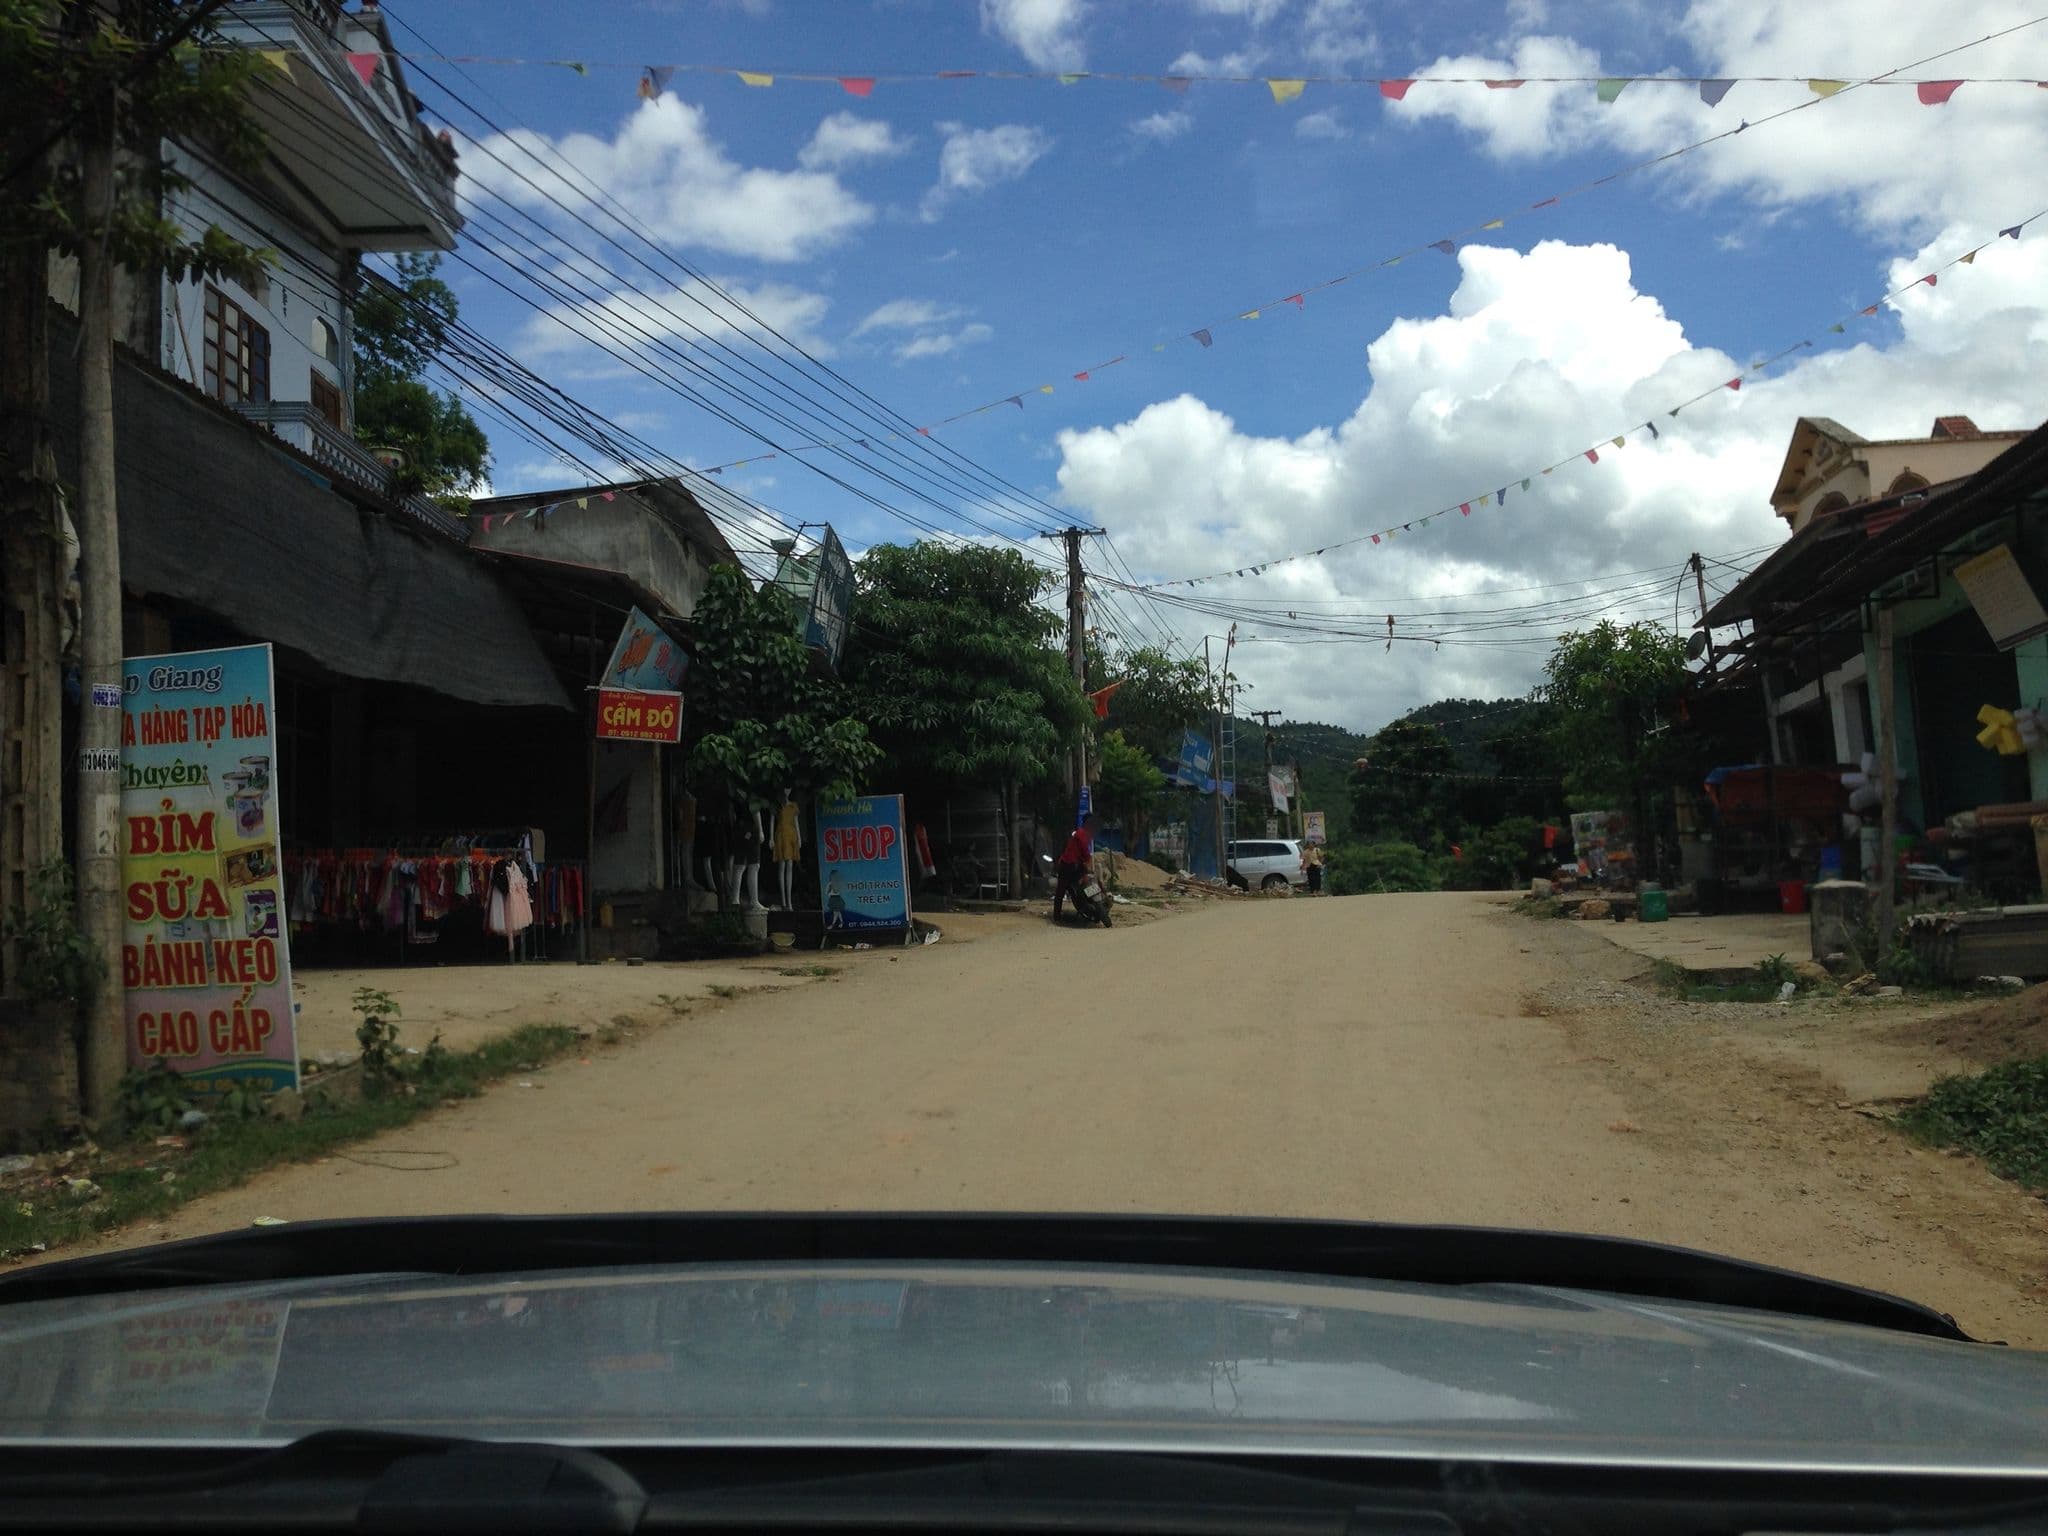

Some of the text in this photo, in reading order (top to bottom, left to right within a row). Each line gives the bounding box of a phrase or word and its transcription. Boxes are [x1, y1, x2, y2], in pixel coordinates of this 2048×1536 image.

[148, 664, 223, 693] Giang
[122, 696, 268, 749] A HÀNG TẠP HÓA
[602, 701, 674, 728] CẦM ĐỒ
[128, 798, 216, 855] BỈM
[823, 825, 896, 862] SHOP
[127, 868, 231, 921] SỮA
[867, 880, 900, 890] TRANG
[877, 894, 891, 904] EM
[123, 935, 277, 993] BÁNH KẸO
[138, 993, 272, 1056] CAO CẤP
